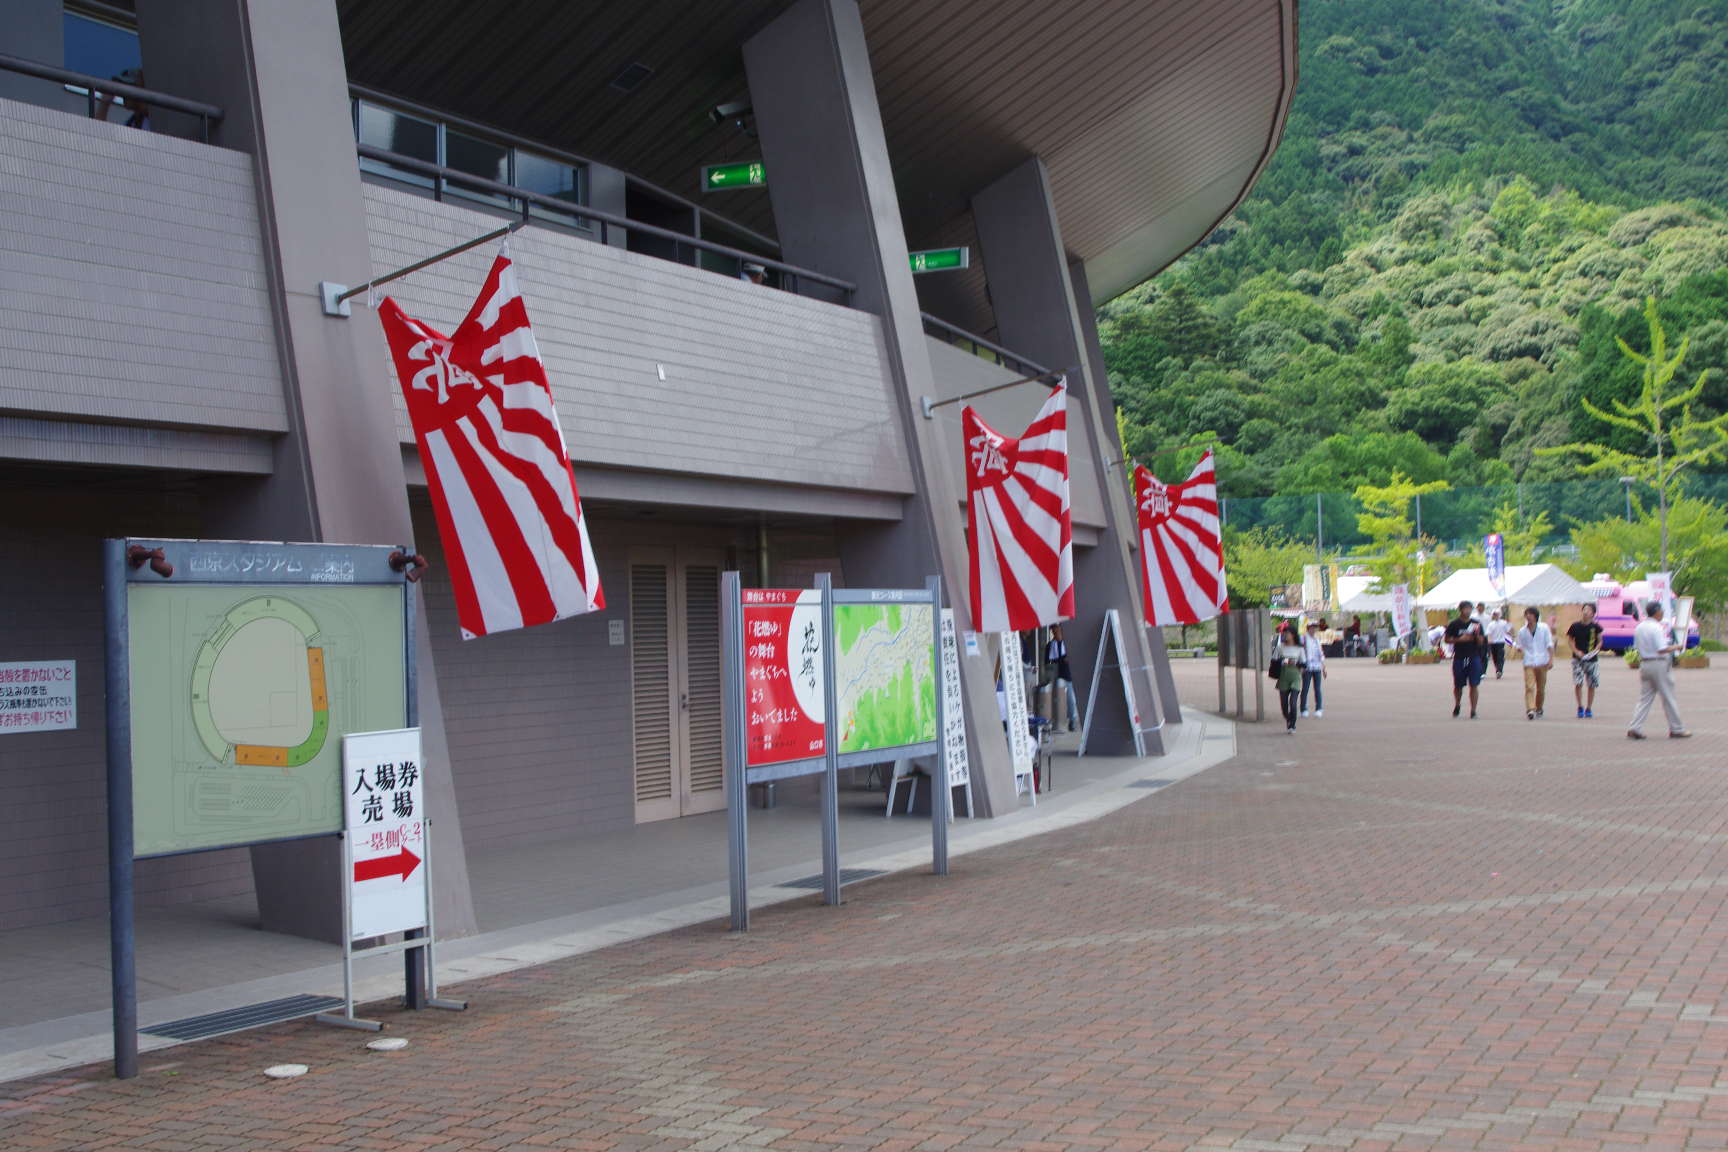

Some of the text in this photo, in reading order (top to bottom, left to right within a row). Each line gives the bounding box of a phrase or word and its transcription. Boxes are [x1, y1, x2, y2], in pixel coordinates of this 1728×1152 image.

[765, 591, 787, 602] やまぐち
[749, 642, 775, 659] の舞台
[750, 664, 787, 680] やまぐちへ
[751, 687, 764, 703] よう
[352, 761, 419, 796] 入場券
[354, 829, 400, 851] 一塁側
